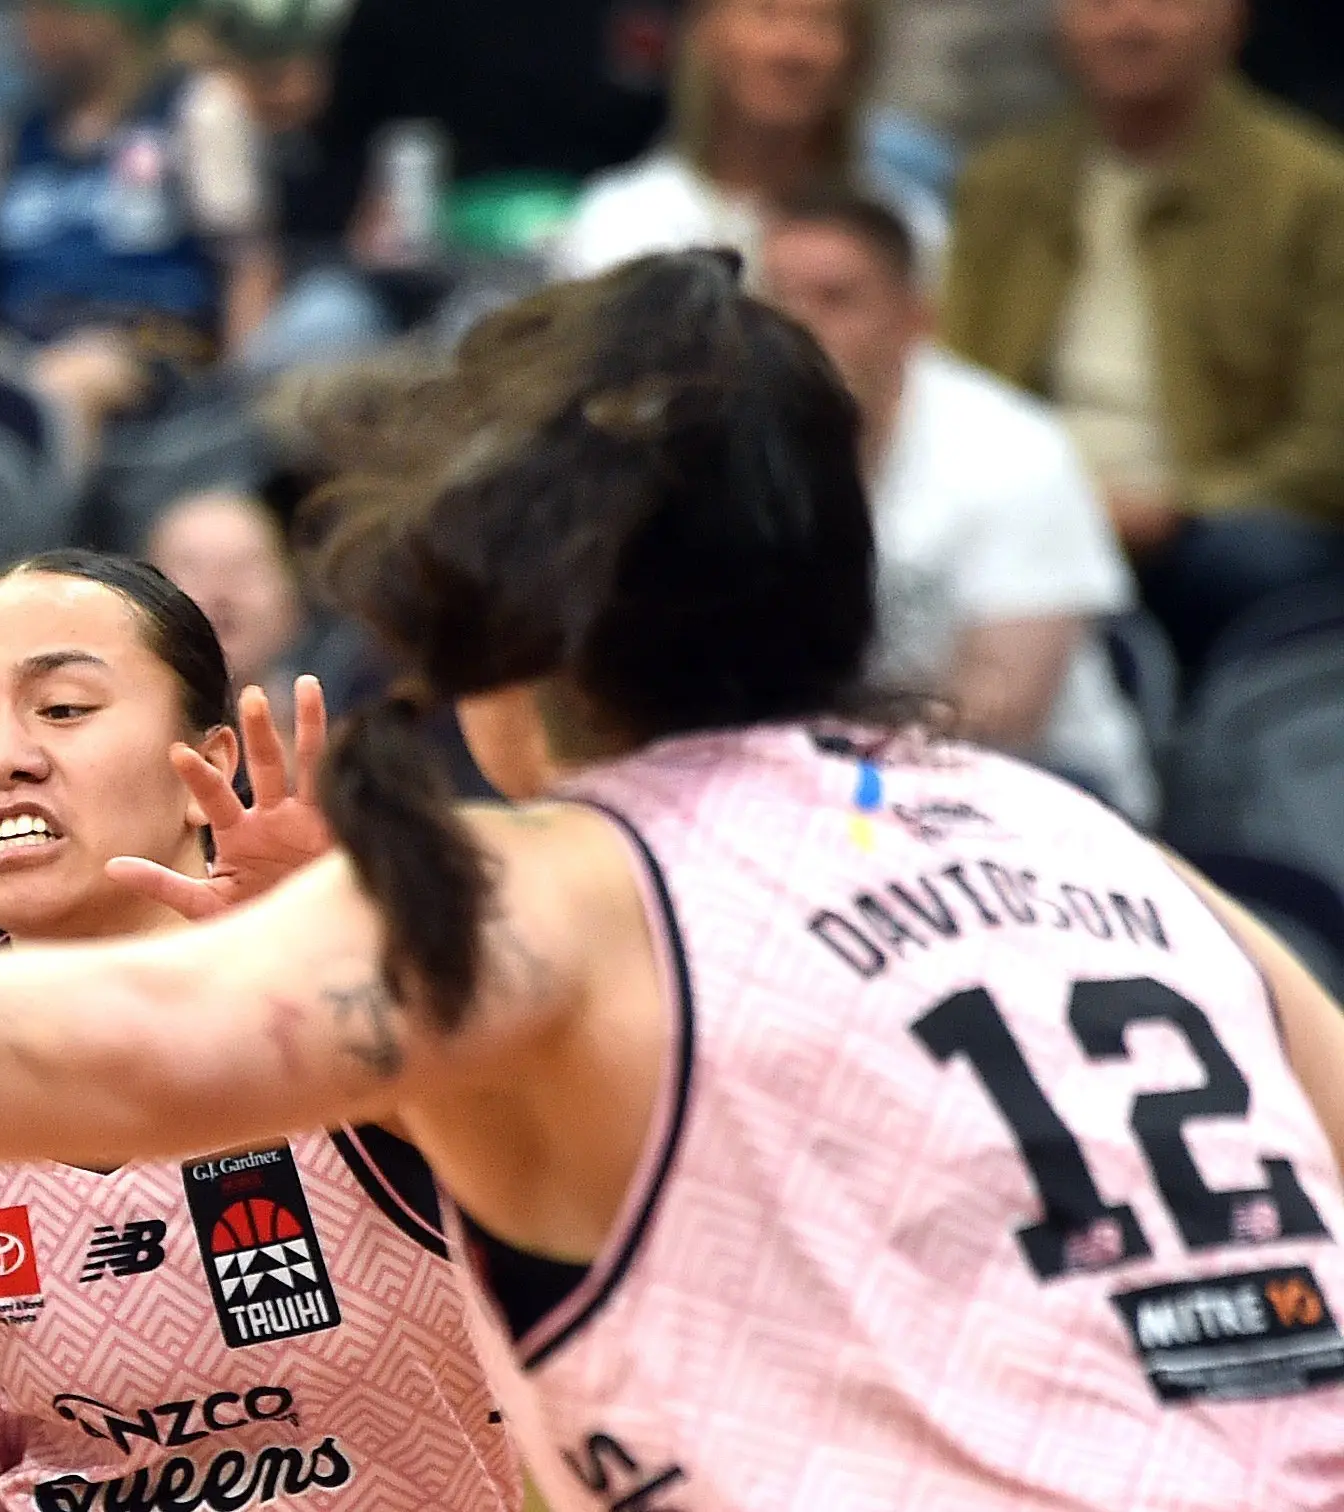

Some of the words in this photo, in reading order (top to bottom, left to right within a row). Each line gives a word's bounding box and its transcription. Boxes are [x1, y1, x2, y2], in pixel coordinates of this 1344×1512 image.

[808, 858, 1170, 979] DAVIDSON
[906, 975, 1337, 1283] 12
[34, 1437, 351, 1512] Queens
